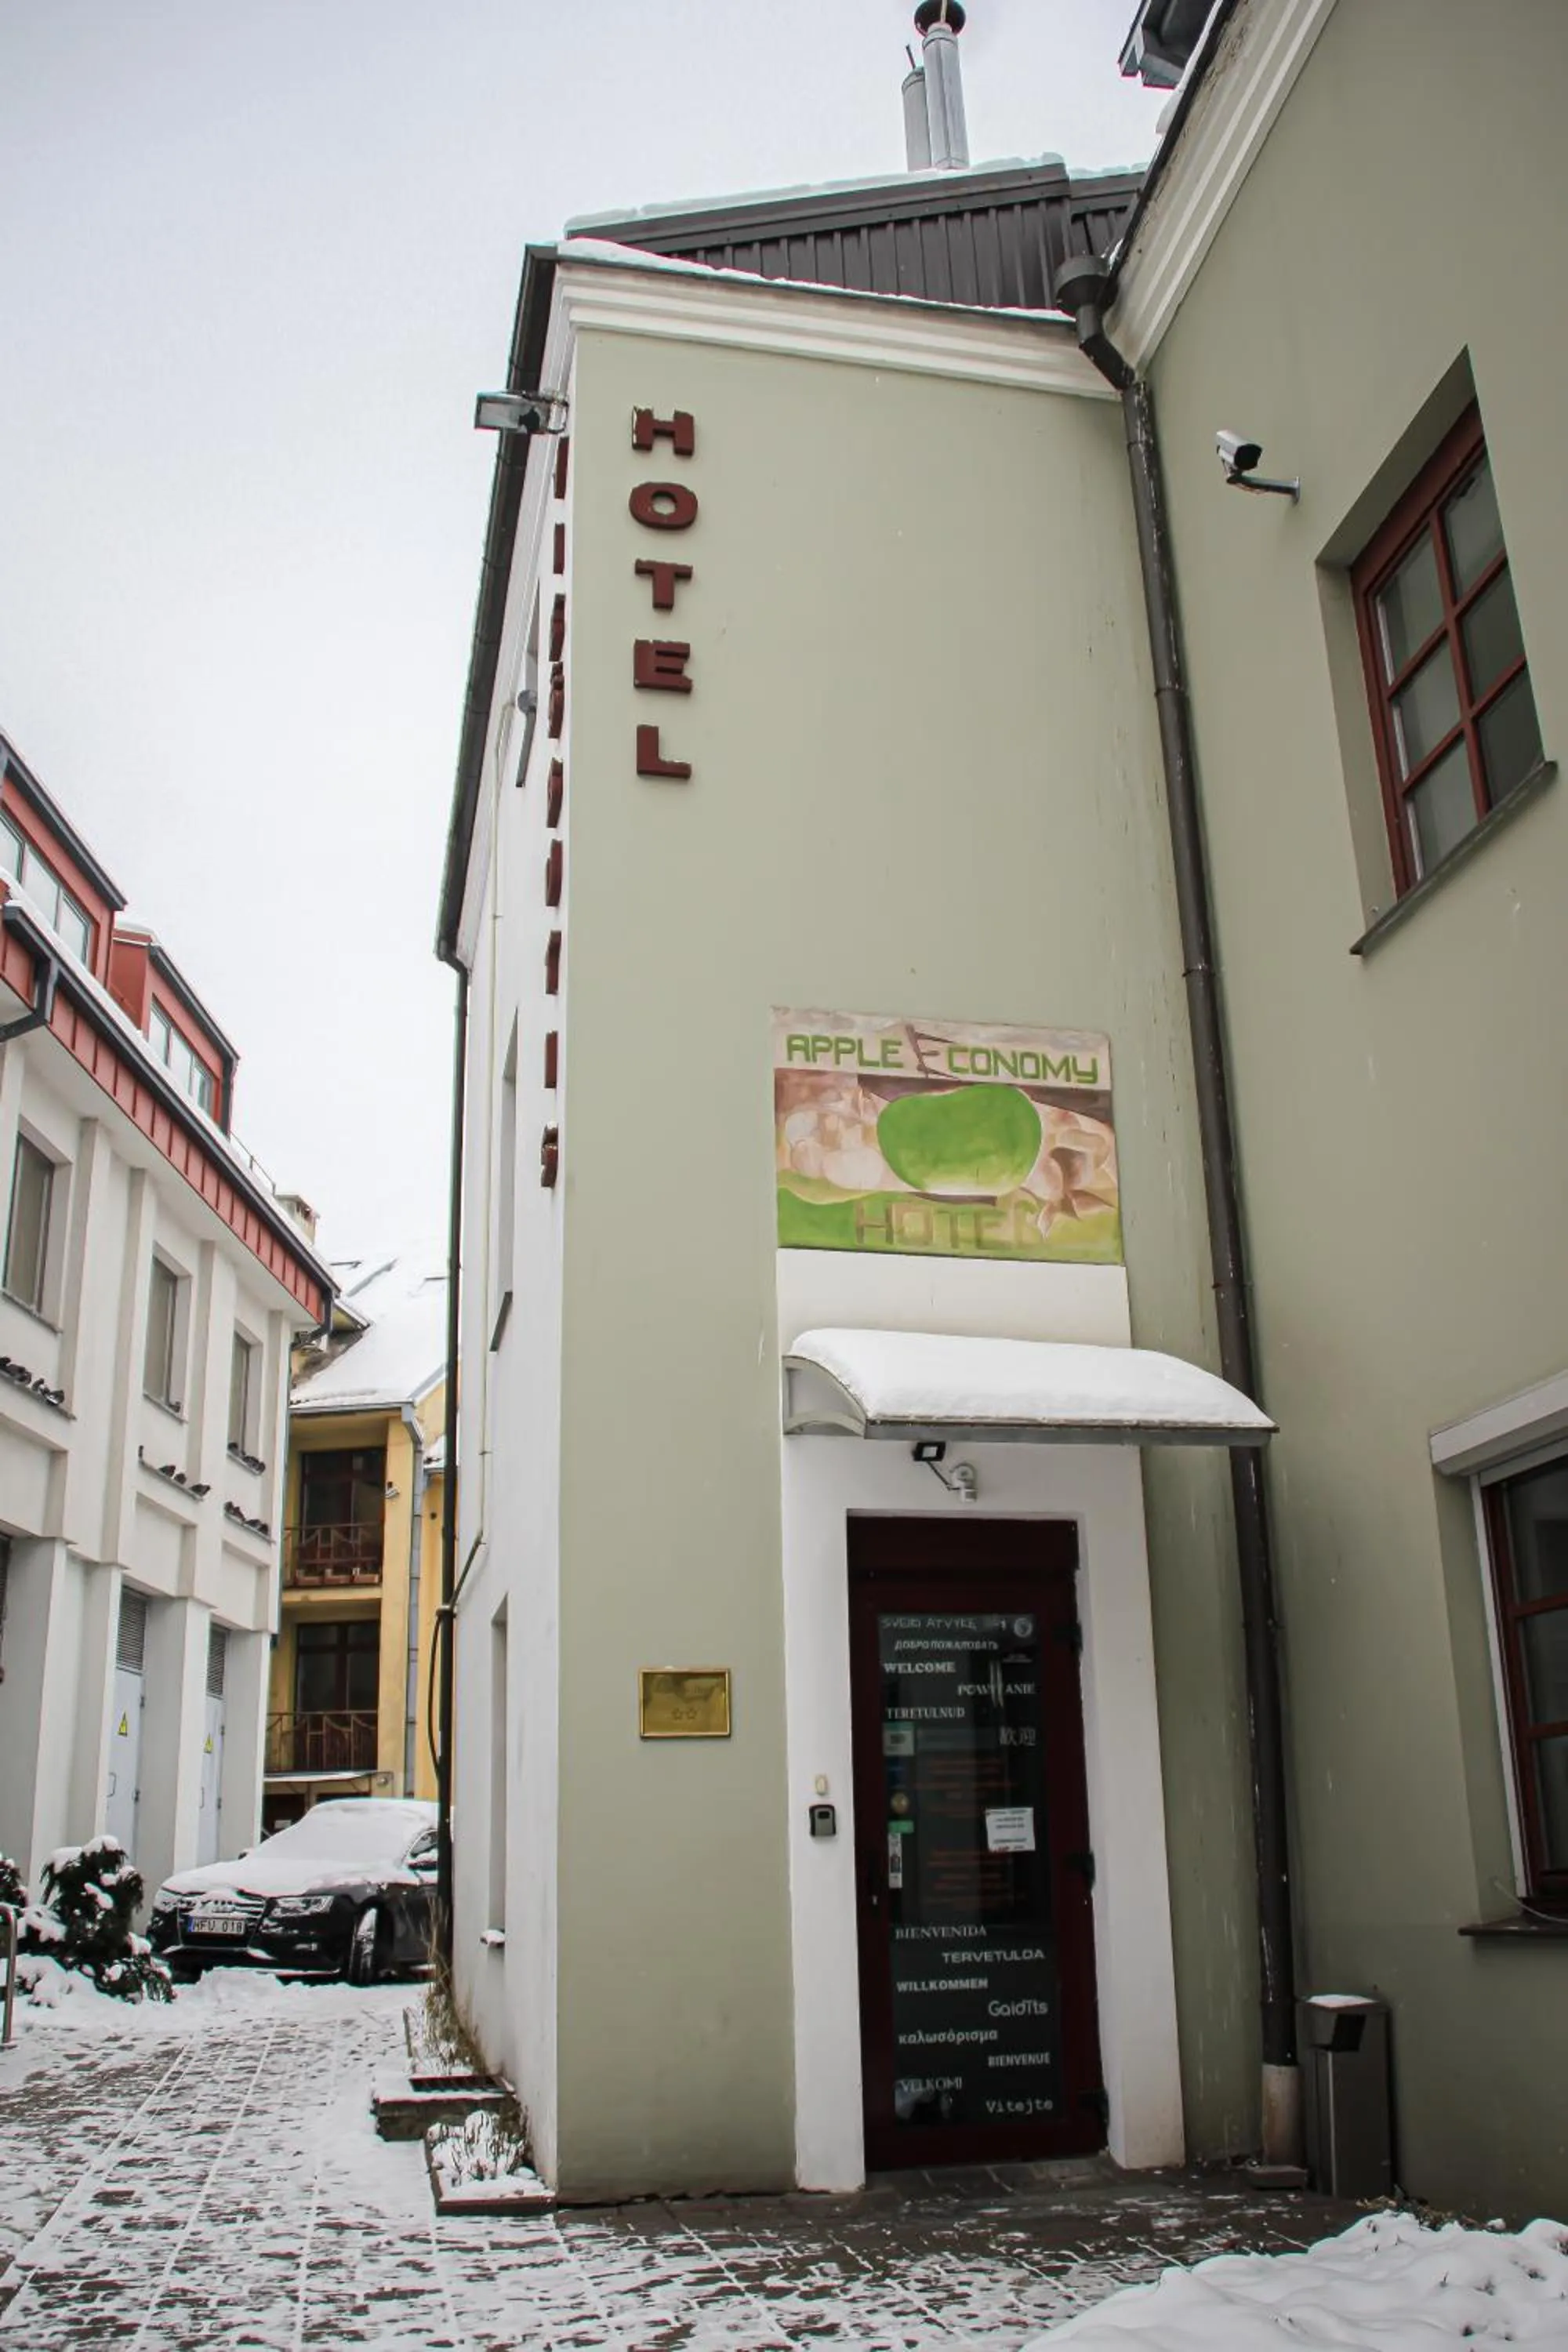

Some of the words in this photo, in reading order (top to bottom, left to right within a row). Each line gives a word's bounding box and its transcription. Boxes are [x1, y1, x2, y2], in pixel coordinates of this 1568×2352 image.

[629, 405, 699, 779] HOTEL
[786, 1034, 904, 1068] APPLE
[883, 1661, 956, 1674] WELCOME
[896, 1925, 987, 1939] BIENVENIDA
[942, 1949, 1046, 1963] TERVETULOA
[897, 1978, 989, 1992] WILLKOMMEN
[988, 2052, 1051, 2067] BIENVENUE
